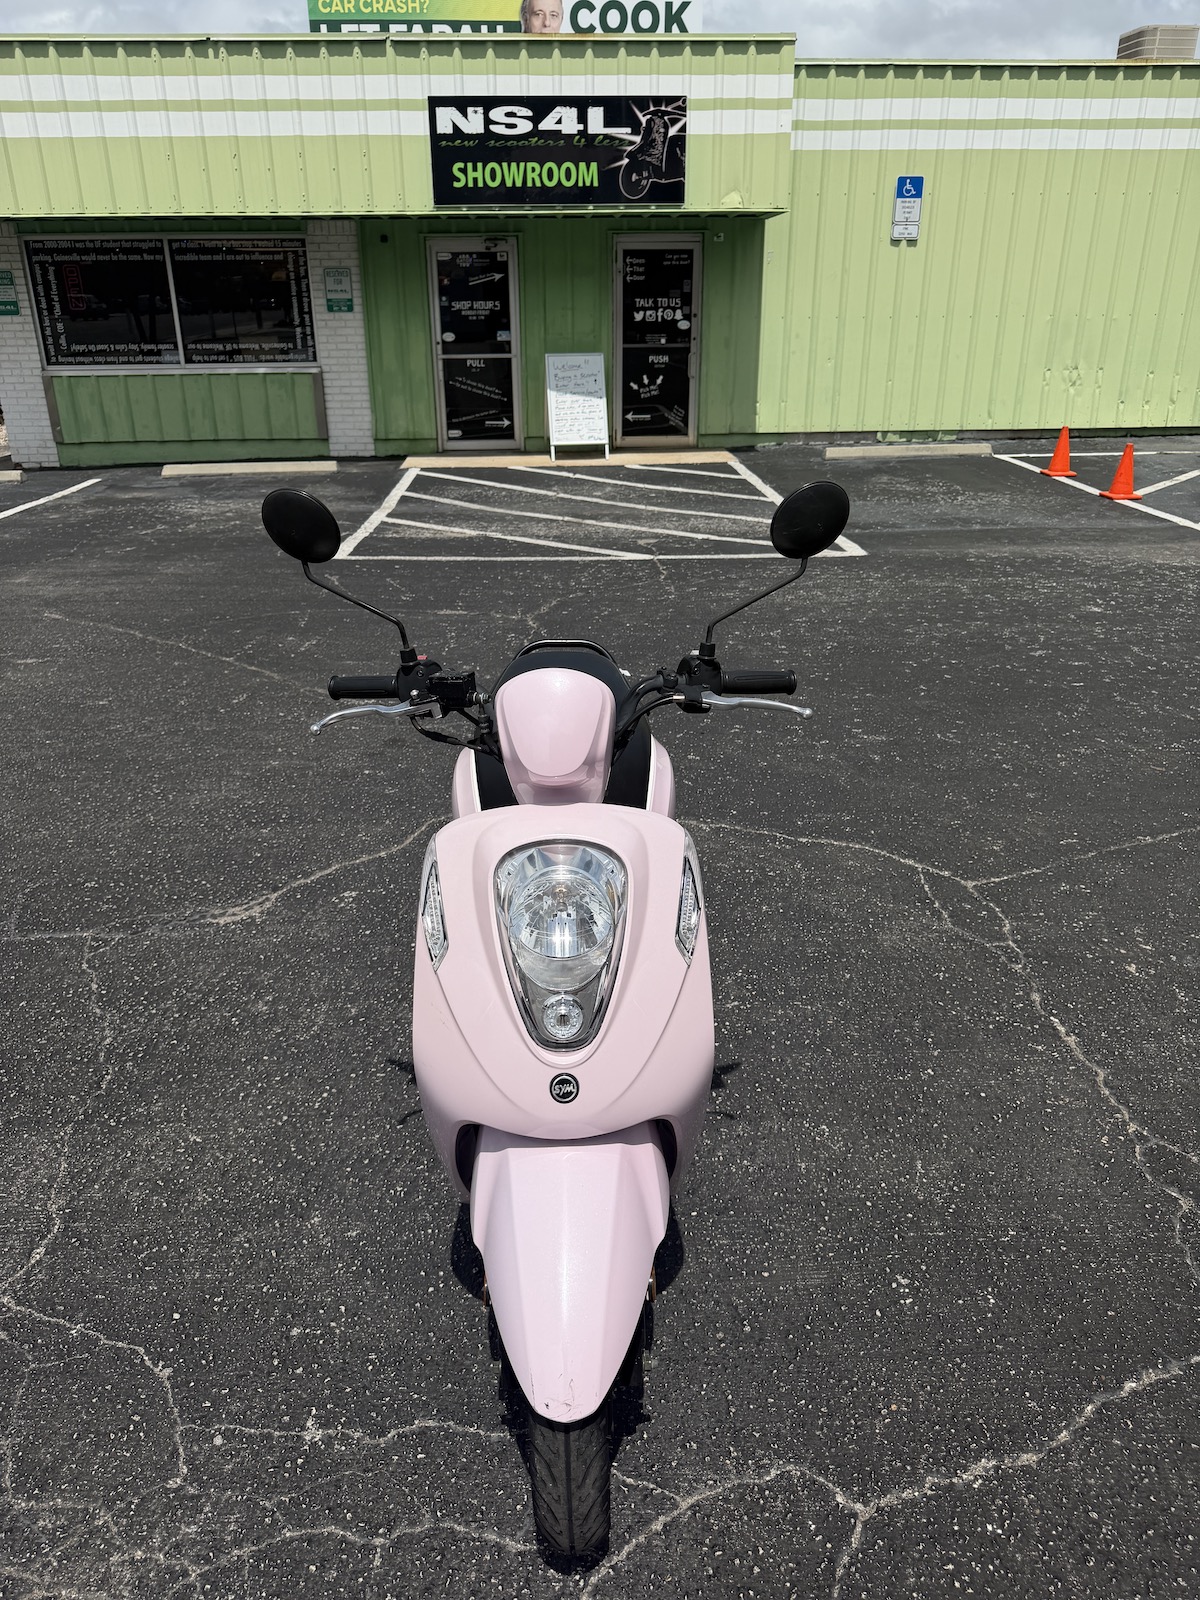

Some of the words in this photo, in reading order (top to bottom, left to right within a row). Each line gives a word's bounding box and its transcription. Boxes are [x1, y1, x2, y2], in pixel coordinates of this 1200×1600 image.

[318, 0, 355, 13] CAR
[359, 0, 429, 13] CRASH?
[570, 0, 692, 33] COOK
[435, 105, 632, 135] NS4L
[438, 139, 479, 148] new
[485, 135, 567, 148] scooters
[572, 135, 587, 148] 4
[593, 135, 634, 148] less
[452, 161, 599, 188] SHOWROOM
[451, 300, 472, 310] SHOP
[473, 300, 501, 310] HOURS
[634, 298, 654, 307] TALK
[656, 298, 668, 307] TO
[669, 298, 682, 307] US
[466, 359, 486, 367] PULL
[648, 355, 669, 363] PUSH
[554, 1083, 576, 1096] SYM
